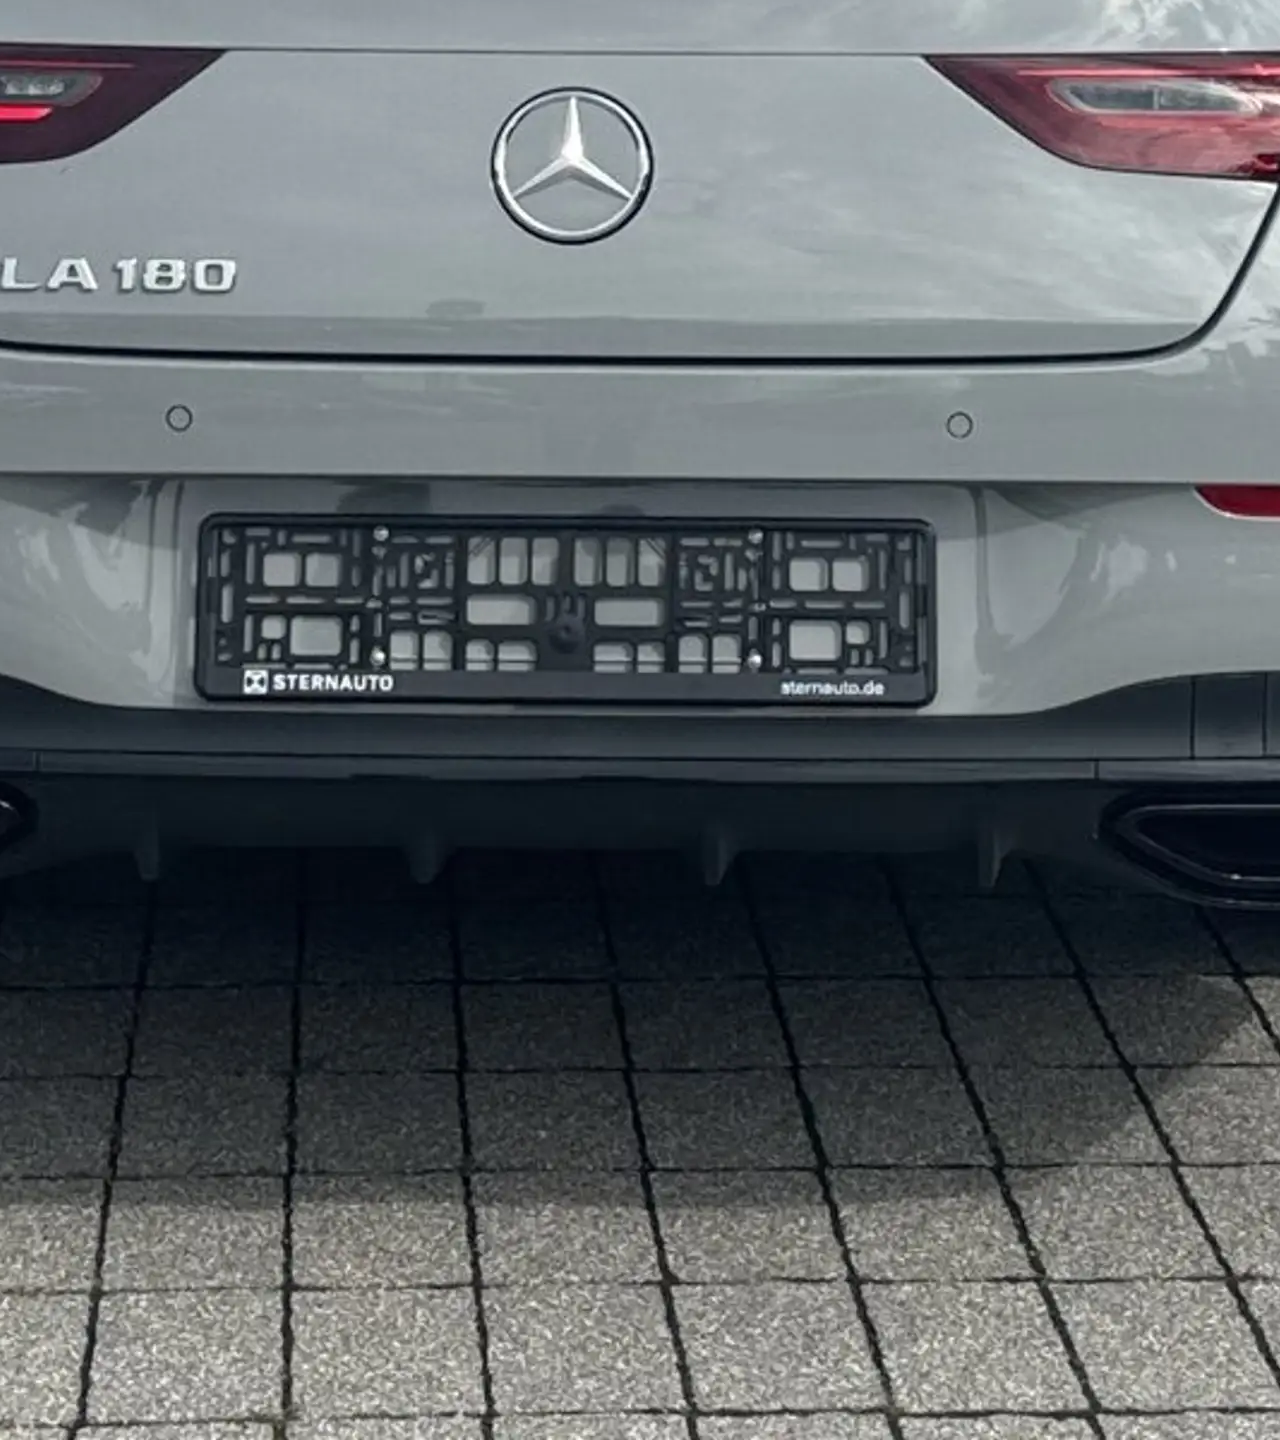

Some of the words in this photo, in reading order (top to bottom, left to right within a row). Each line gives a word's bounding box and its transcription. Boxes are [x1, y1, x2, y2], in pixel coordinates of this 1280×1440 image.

[116, 256, 237, 292] 180
[272, 673, 394, 692] STERNAUTO
[781, 680, 885, 696] sternauto.de
